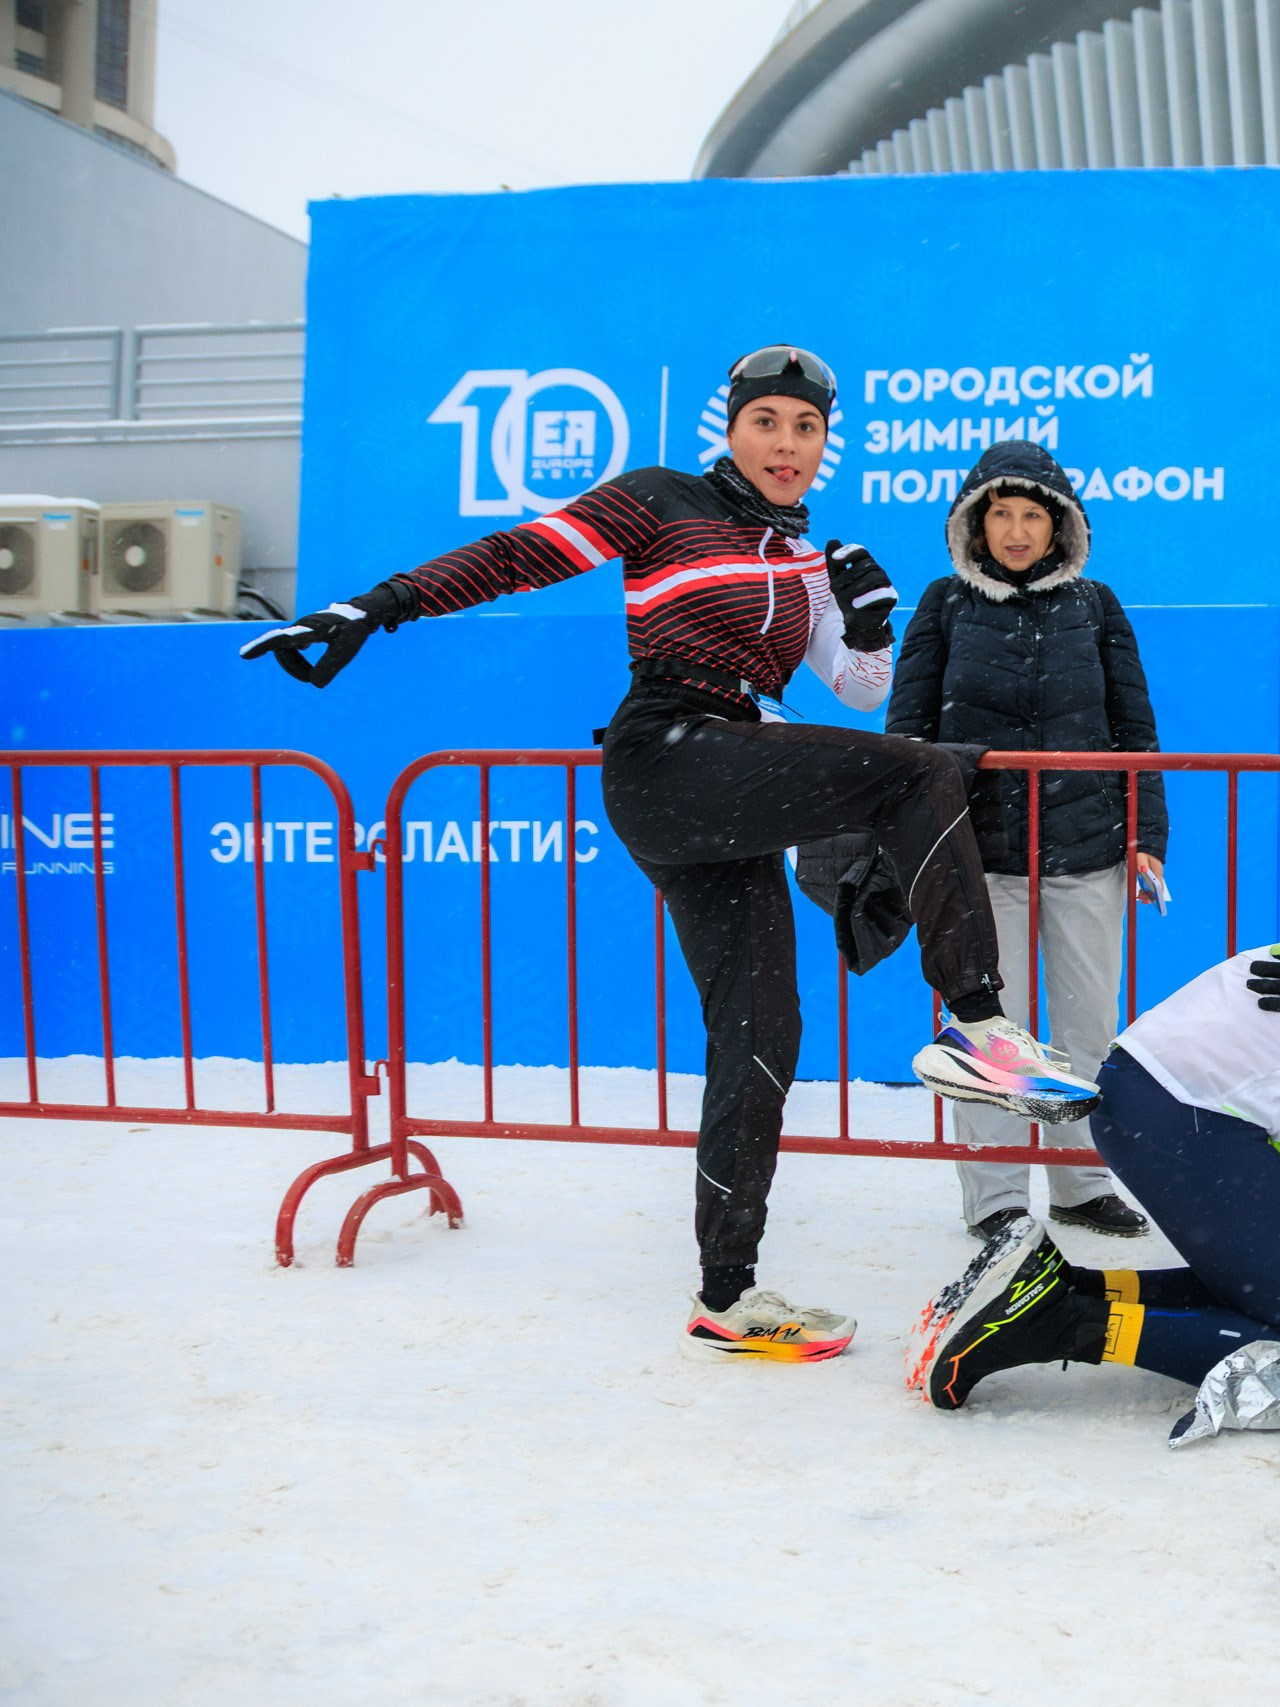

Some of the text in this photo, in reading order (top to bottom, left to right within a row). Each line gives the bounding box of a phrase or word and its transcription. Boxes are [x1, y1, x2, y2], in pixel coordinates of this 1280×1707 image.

[864, 353, 1154, 406] ГОРОДСКОЙ
[864, 405, 1059, 454] ЗИМНИЙ
[531, 457, 595, 469] EUROPE
[531, 468, 595, 480] ASIA
[862, 465, 1225, 504] ПОЛРАФОН
[1, 861, 114, 875] RUNNING
[1004, 1283, 1045, 1316] SALOMON
